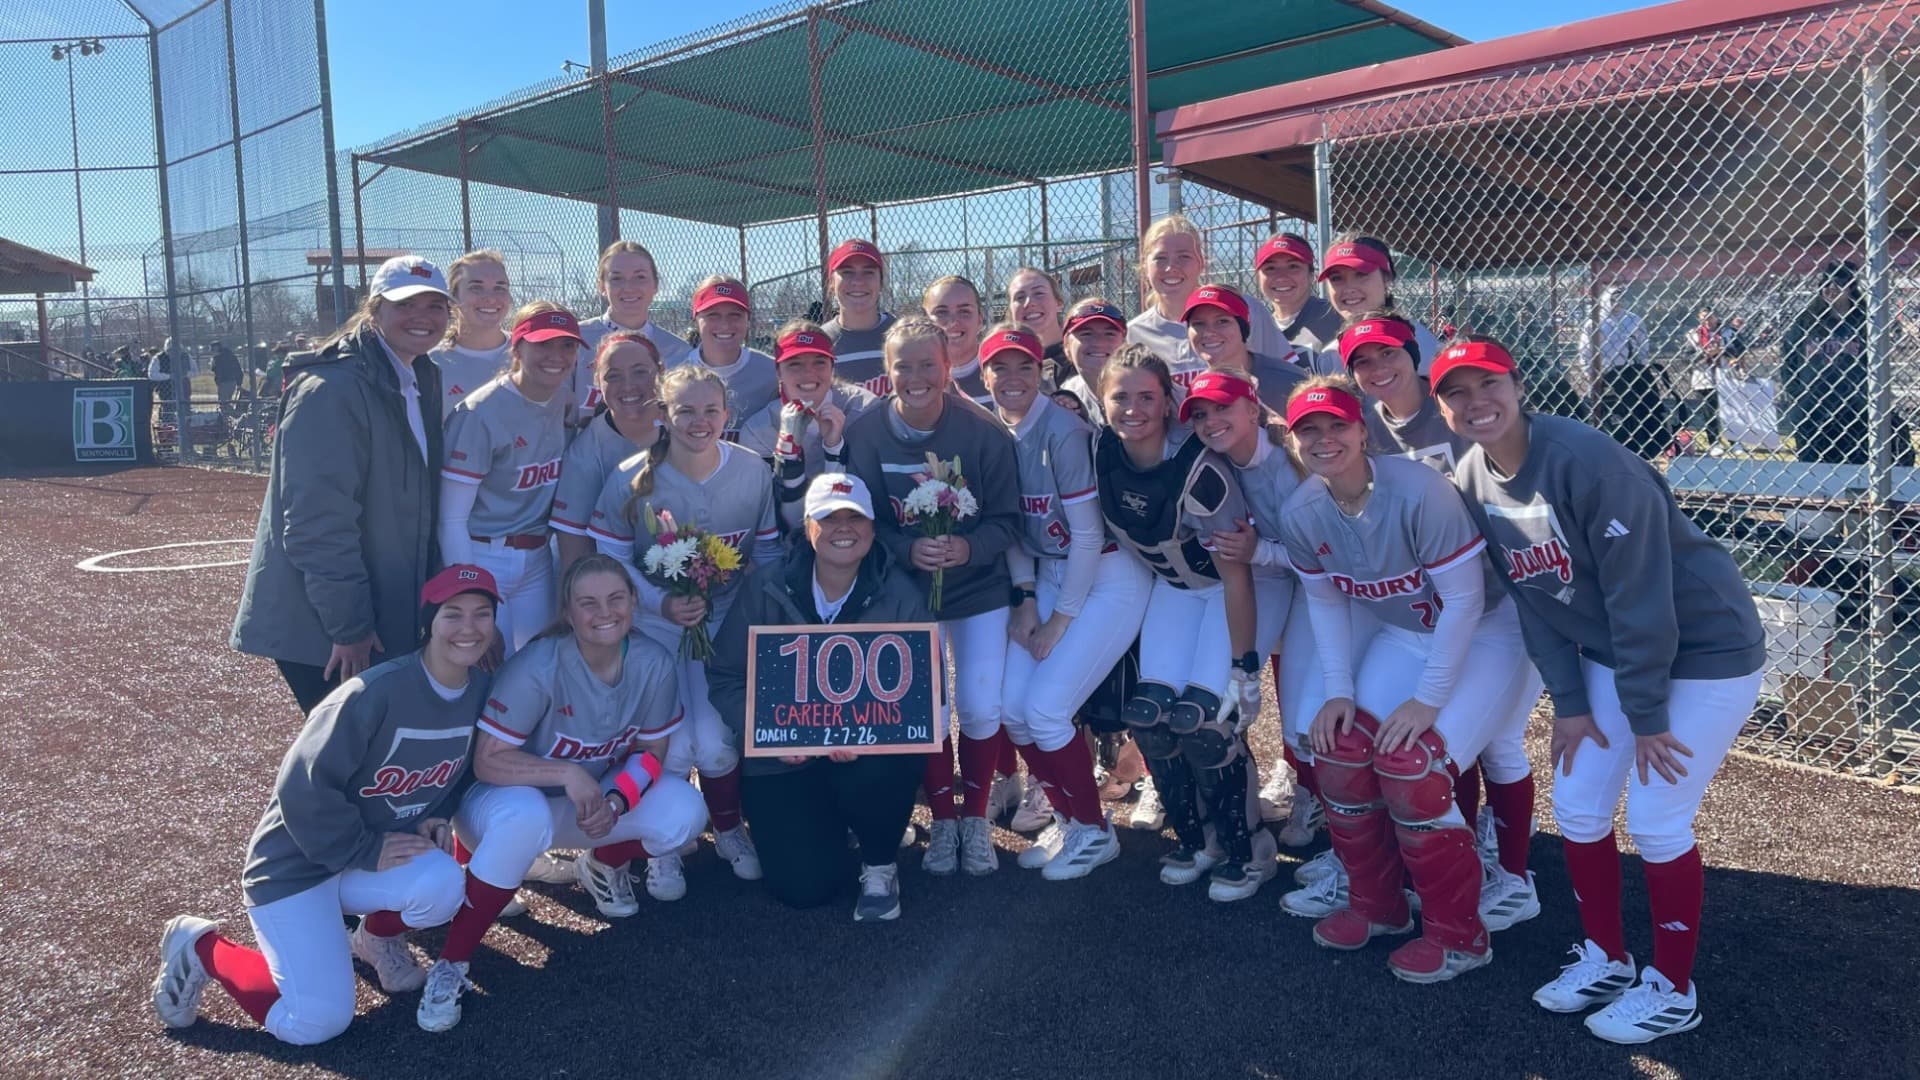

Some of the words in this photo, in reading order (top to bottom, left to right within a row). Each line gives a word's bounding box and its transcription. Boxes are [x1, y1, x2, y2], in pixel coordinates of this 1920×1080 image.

[1047, 520, 1071, 550] 9
[459, 570, 479, 580] DU
[1329, 567, 1424, 601] DRURY
[779, 634, 913, 704] 100
[774, 703, 843, 727] CAREER
[852, 702, 902, 726] WINS
[755, 728, 788, 743] COACH
[823, 726, 878, 746] 2-7-26
[907, 725, 928, 740] DU
